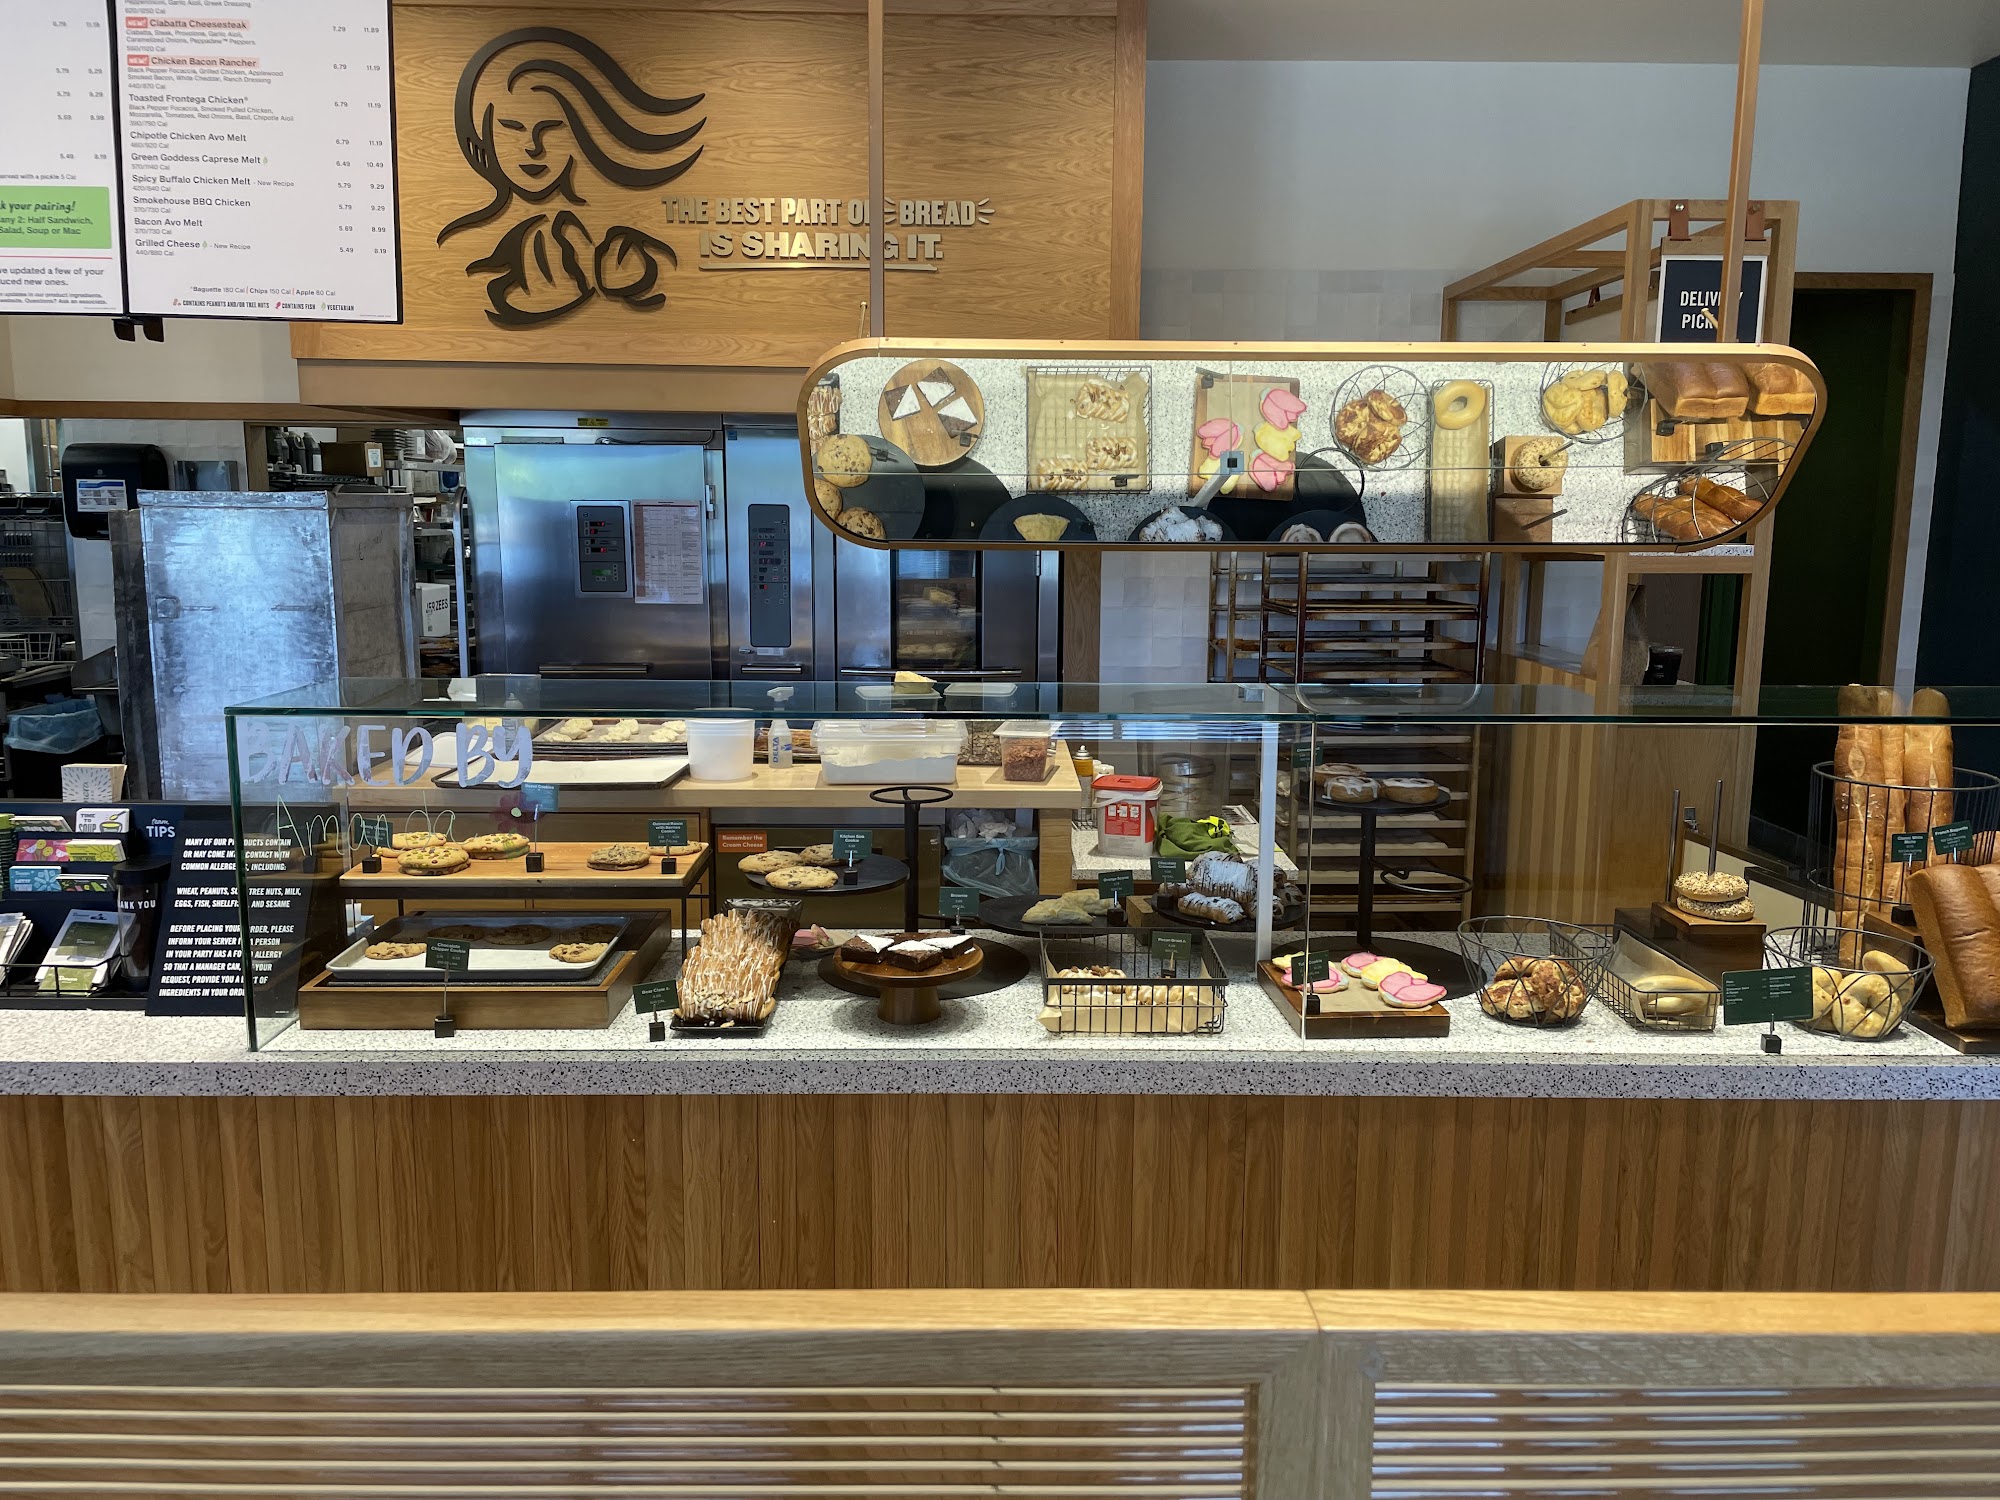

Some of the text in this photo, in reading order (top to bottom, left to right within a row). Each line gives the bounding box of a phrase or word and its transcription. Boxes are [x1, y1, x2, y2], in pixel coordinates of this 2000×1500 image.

[150, 19, 247, 29] Ciabatta Cheesesteak
[151, 57, 256, 67] Chicken Bacon Rancher
[129, 94, 163, 102] Toasted
[166, 95, 205, 104] Frontega
[130, 132, 167, 141] Chipotle
[170, 132, 206, 141] Chicken
[227, 134, 247, 142] Melt
[131, 153, 260, 164] Green Goddess Caprese Melt
[132, 175, 157, 184] Spicy
[159, 175, 190, 184] Buffalo
[193, 176, 229, 185] Chicken
[231, 178, 251, 186] Melt
[273, 180, 294, 188] Recipe
[133, 196, 250, 207] Smokehouse BBQ Chicken
[9, 201, 76, 213] your pairing!
[661, 196, 709, 224] THE
[715, 198, 775, 225] BEST
[781, 198, 842, 225] PART
[900, 200, 976, 226] BREAD
[134, 218, 162, 226] Bacon
[183, 219, 202, 227] Melt
[27, 227, 49, 235] Soup
[135, 239, 200, 248] Grilled Cheese
[700, 231, 944, 260] IS SHARING IT.
[10, 267, 46, 276] updated
[55, 267, 71, 275] few
[237, 719, 533, 788] BAKED BY
[152, 817, 170, 825] team
[146, 826, 176, 838] TIPS
[185, 838, 202, 846] MANY
[204, 838, 213, 846] OF
[214, 838, 227, 846] OUR
[274, 851, 290, 859] WITH
[181, 863, 287, 871] COMMON ALLERGE, INCLUDING:
[177, 887, 302, 896] WHEAT, PEANUTS, TREE NUTS, MILK,
[118, 900, 156, 909] ANK YOU
[174, 900, 291, 909] EGGS, FISH, AND SESAME
[170, 925, 195, 933] BEFORE
[196, 925, 223, 933] PLACING
[270, 925, 294, 933] PLEASE
[168, 938, 193, 946] INFORM
[212, 938, 237, 946] SERVER
[255, 938, 280, 946] PERSON
[166, 950, 283, 958] IN YOUR PARTY HAS ALLERGY
[163, 963, 272, 971] SO THAT MANAGER CAN, YOUR
[161, 976, 190, 984] REQUEST,
[192, 976, 221, 984] PROVIDE
[258, 976, 268, 984] OF
[158, 988, 229, 997] INGREDIENTS IN YOUR
